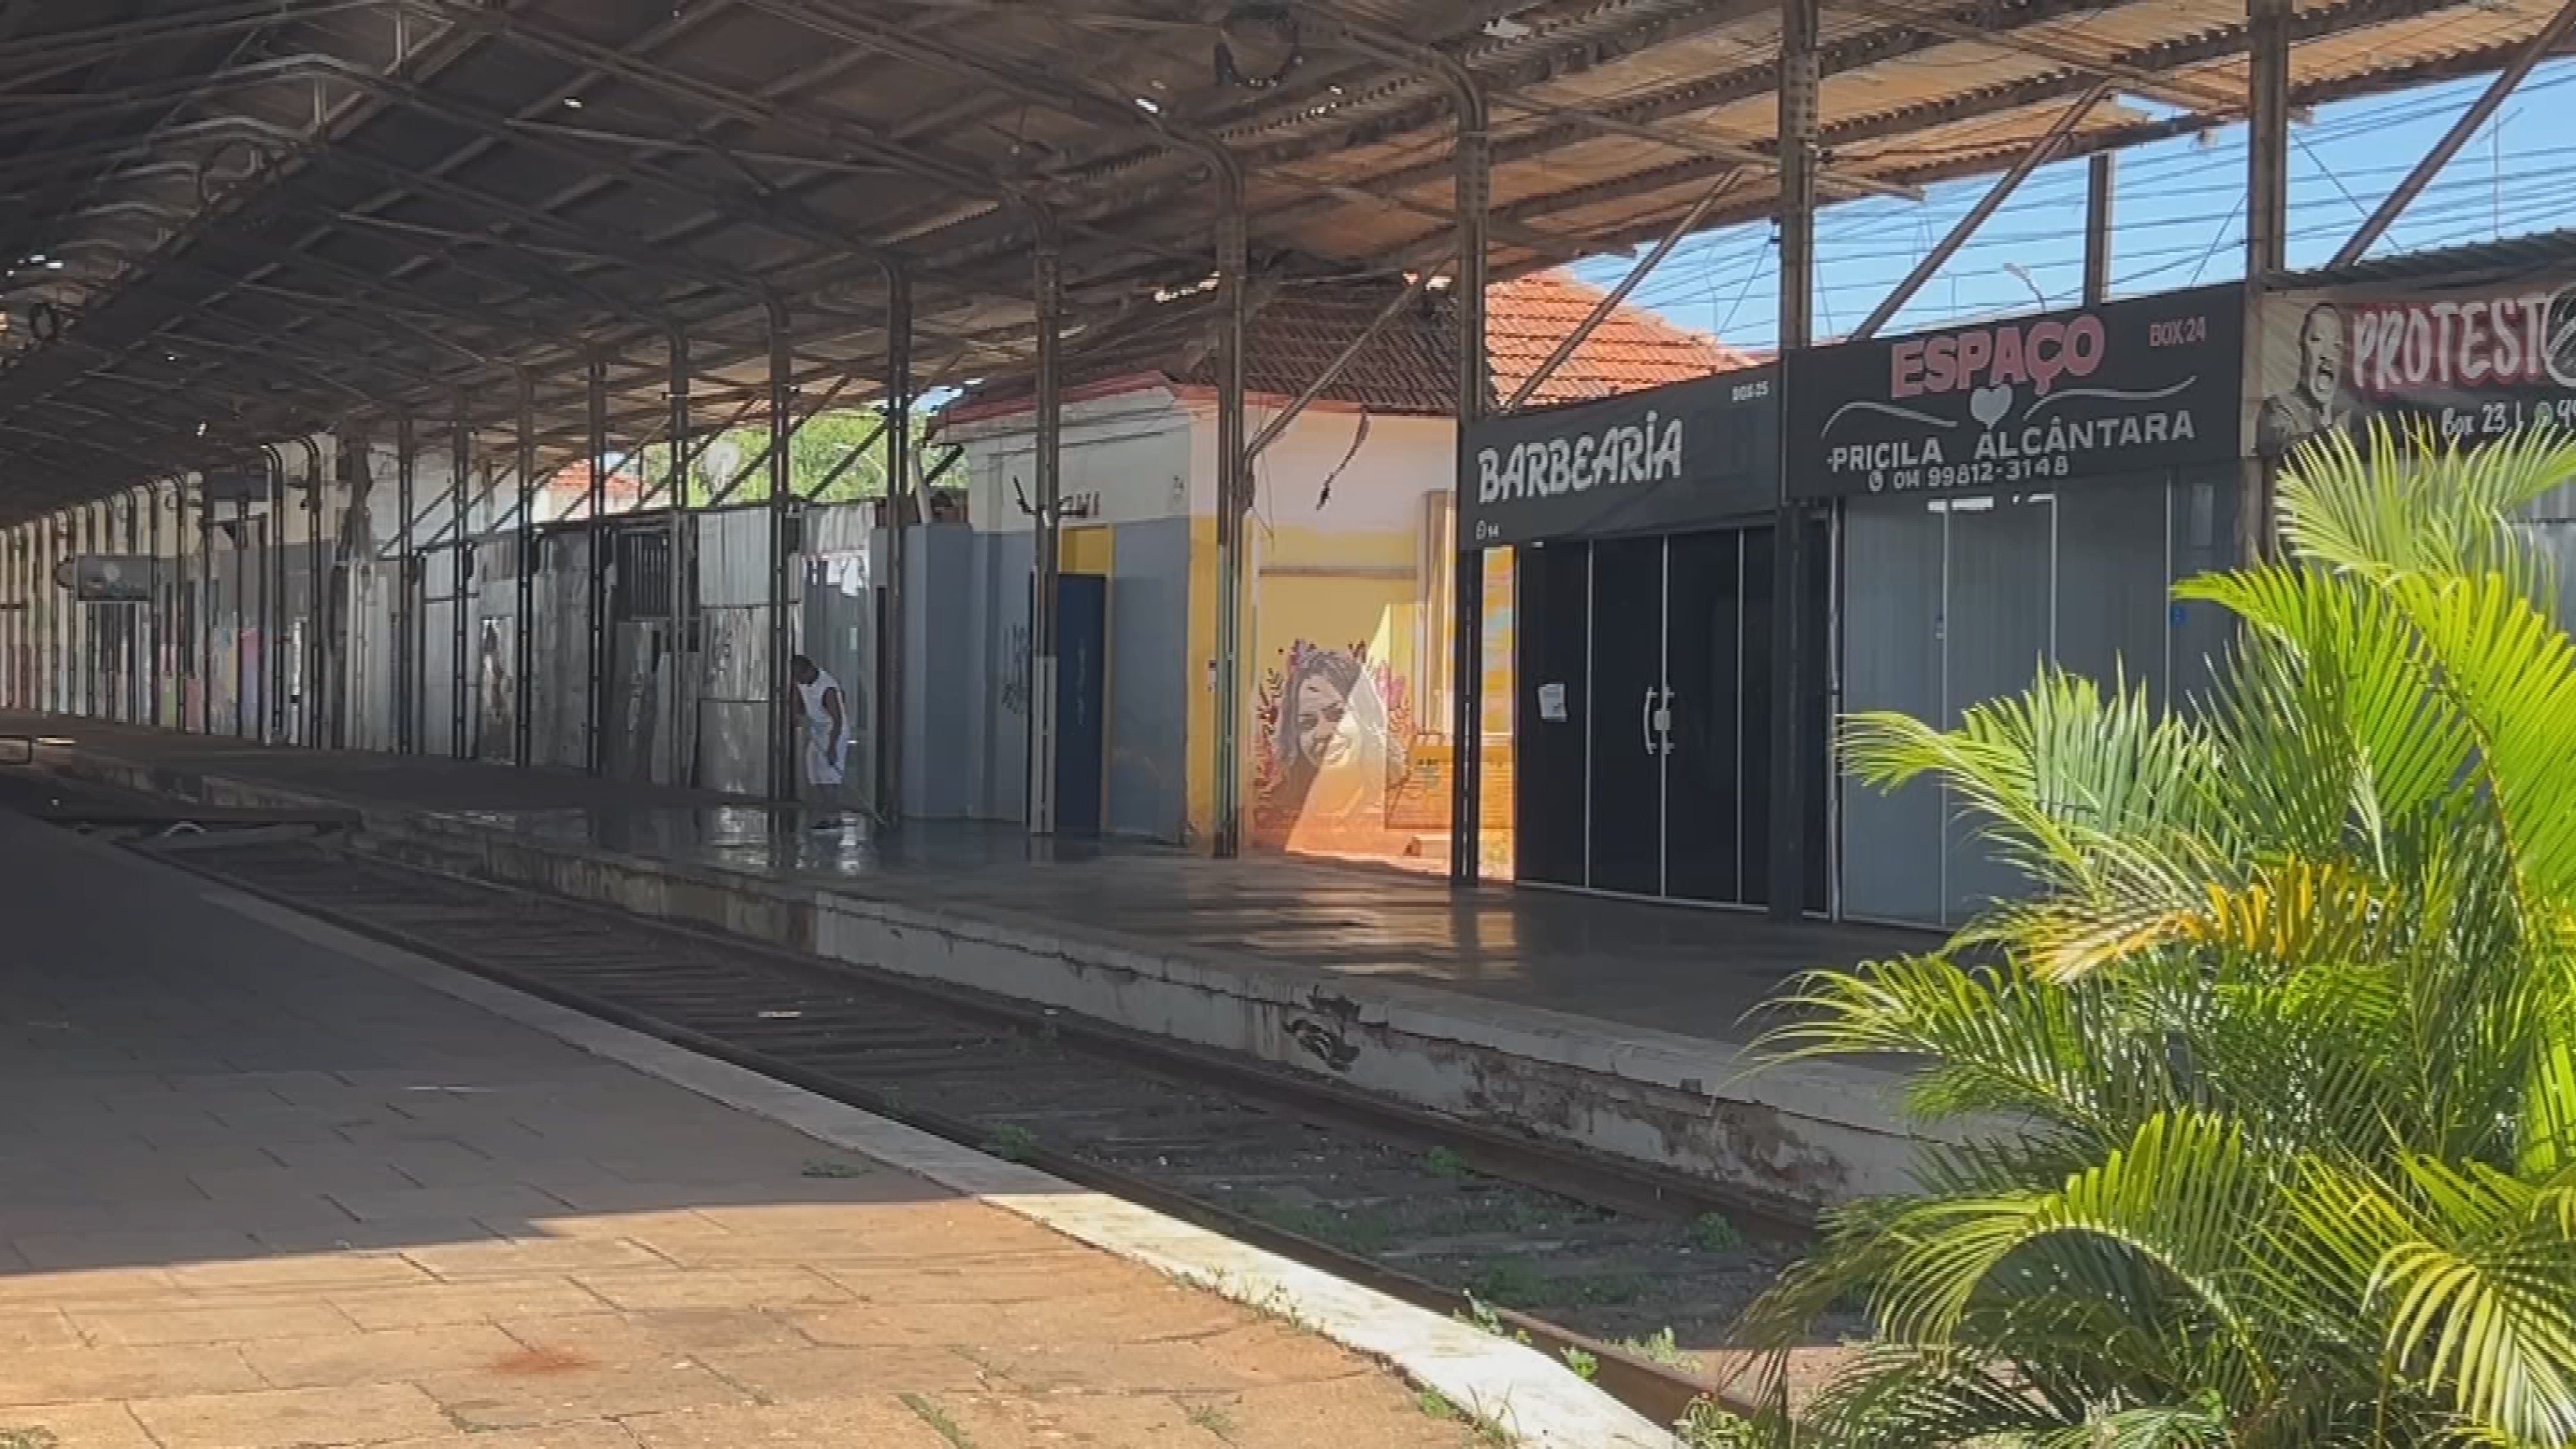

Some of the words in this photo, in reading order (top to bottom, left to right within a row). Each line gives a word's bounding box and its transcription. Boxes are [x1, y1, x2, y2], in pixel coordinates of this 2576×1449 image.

[1891, 314, 2105, 399] ESPAÇO
[1831, 437, 1944, 472] PRICILA
[1974, 410, 2196, 460] ALCÂNTARA
[2481, 401, 2506, 433] 23
[1478, 411, 1682, 504] BARBEARIA
[1927, 455, 2070, 486] 99812-3148
